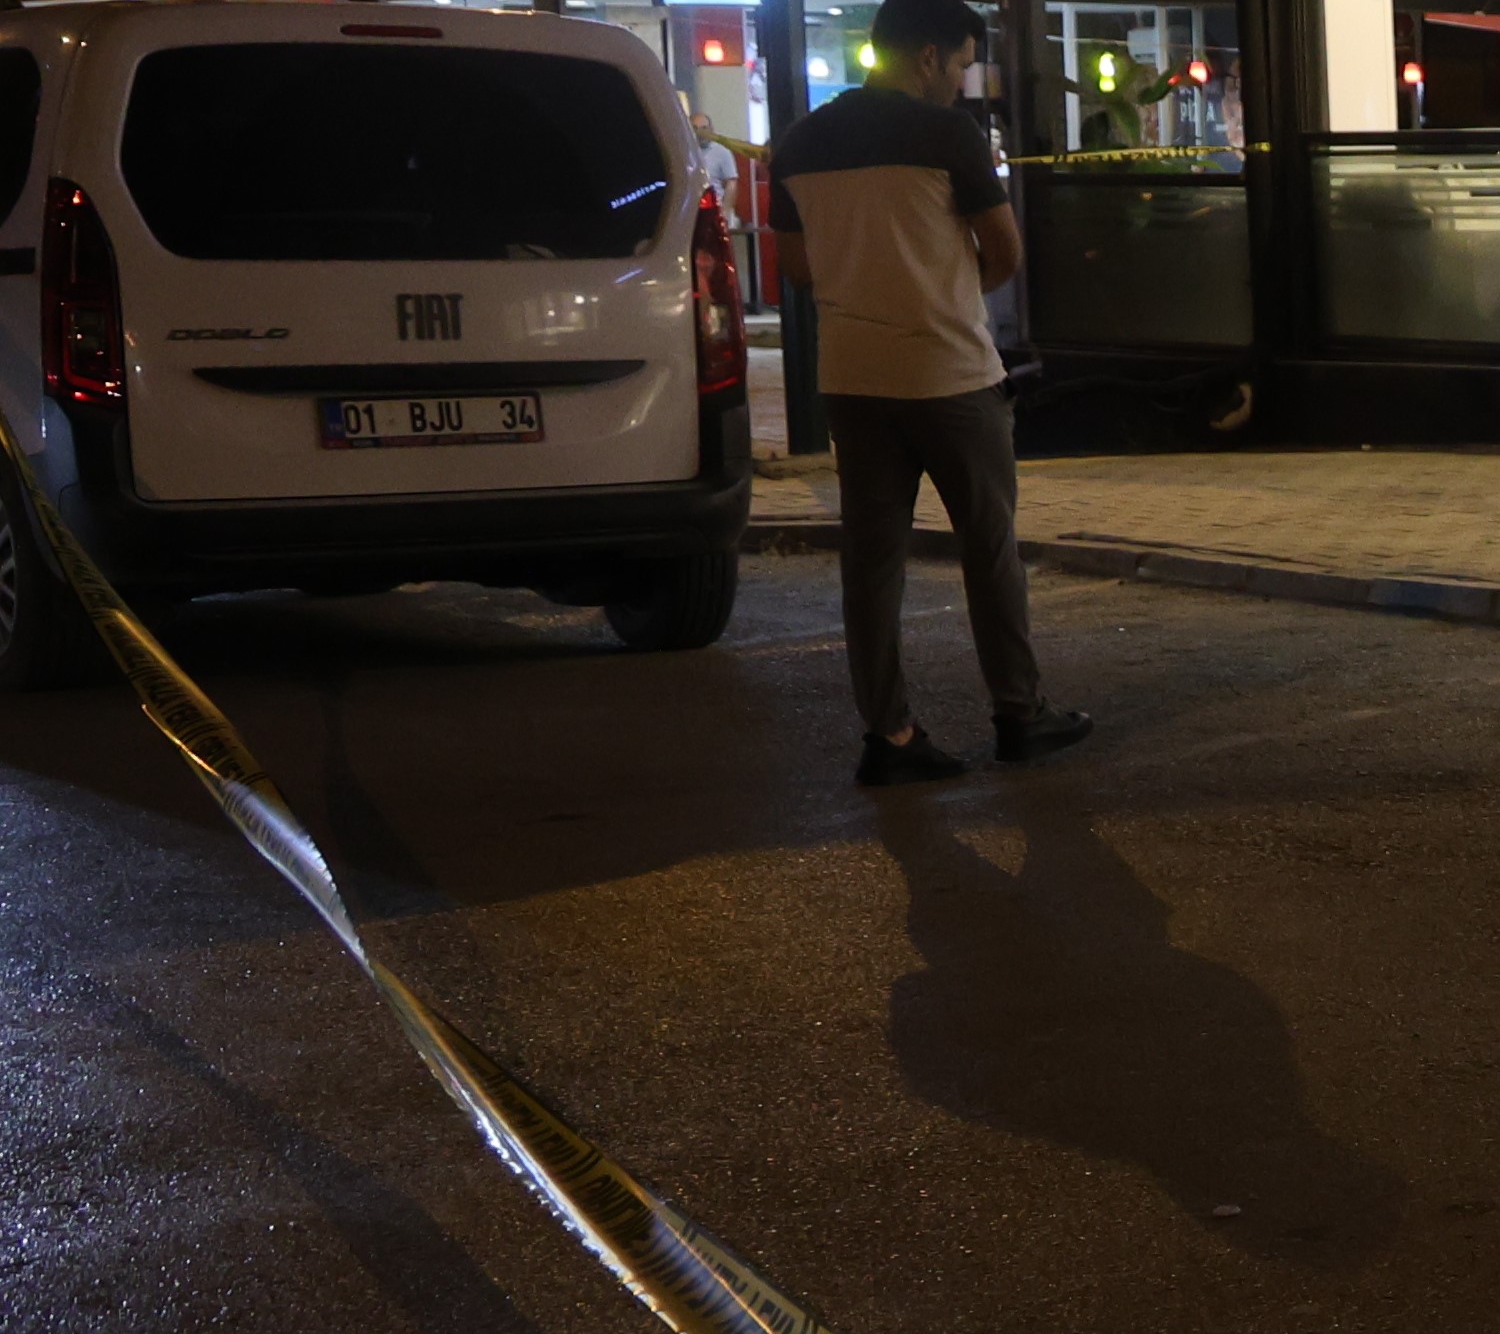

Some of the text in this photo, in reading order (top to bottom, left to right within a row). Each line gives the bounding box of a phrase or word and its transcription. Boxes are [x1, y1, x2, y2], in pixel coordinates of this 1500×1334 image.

[166, 327, 291, 341] DOBLO
[397, 293, 463, 341] FIAT
[344, 399, 535, 435] 01 BJU 34
